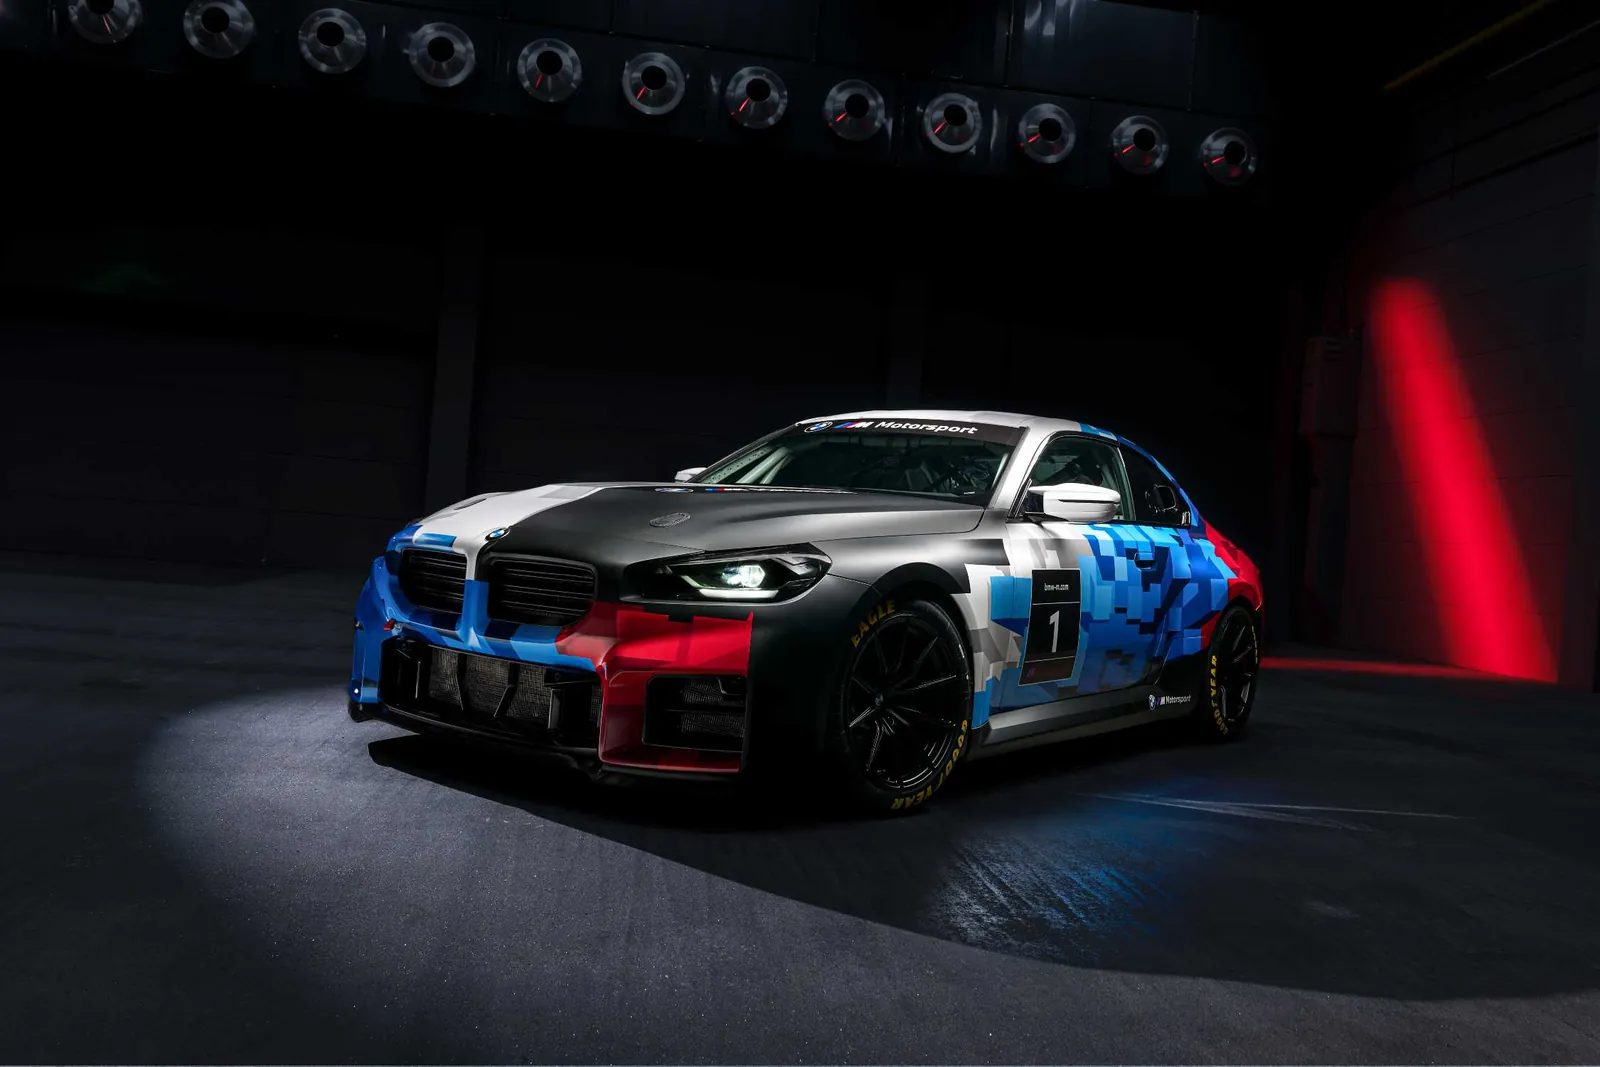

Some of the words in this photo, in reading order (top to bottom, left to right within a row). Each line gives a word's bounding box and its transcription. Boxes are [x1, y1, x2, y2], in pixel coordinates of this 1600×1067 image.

[875, 421, 978, 434] Motorsport
[851, 599, 895, 648] EAGLE
[1048, 610, 1060, 653] 1
[1165, 694, 1192, 705] Motorsport
